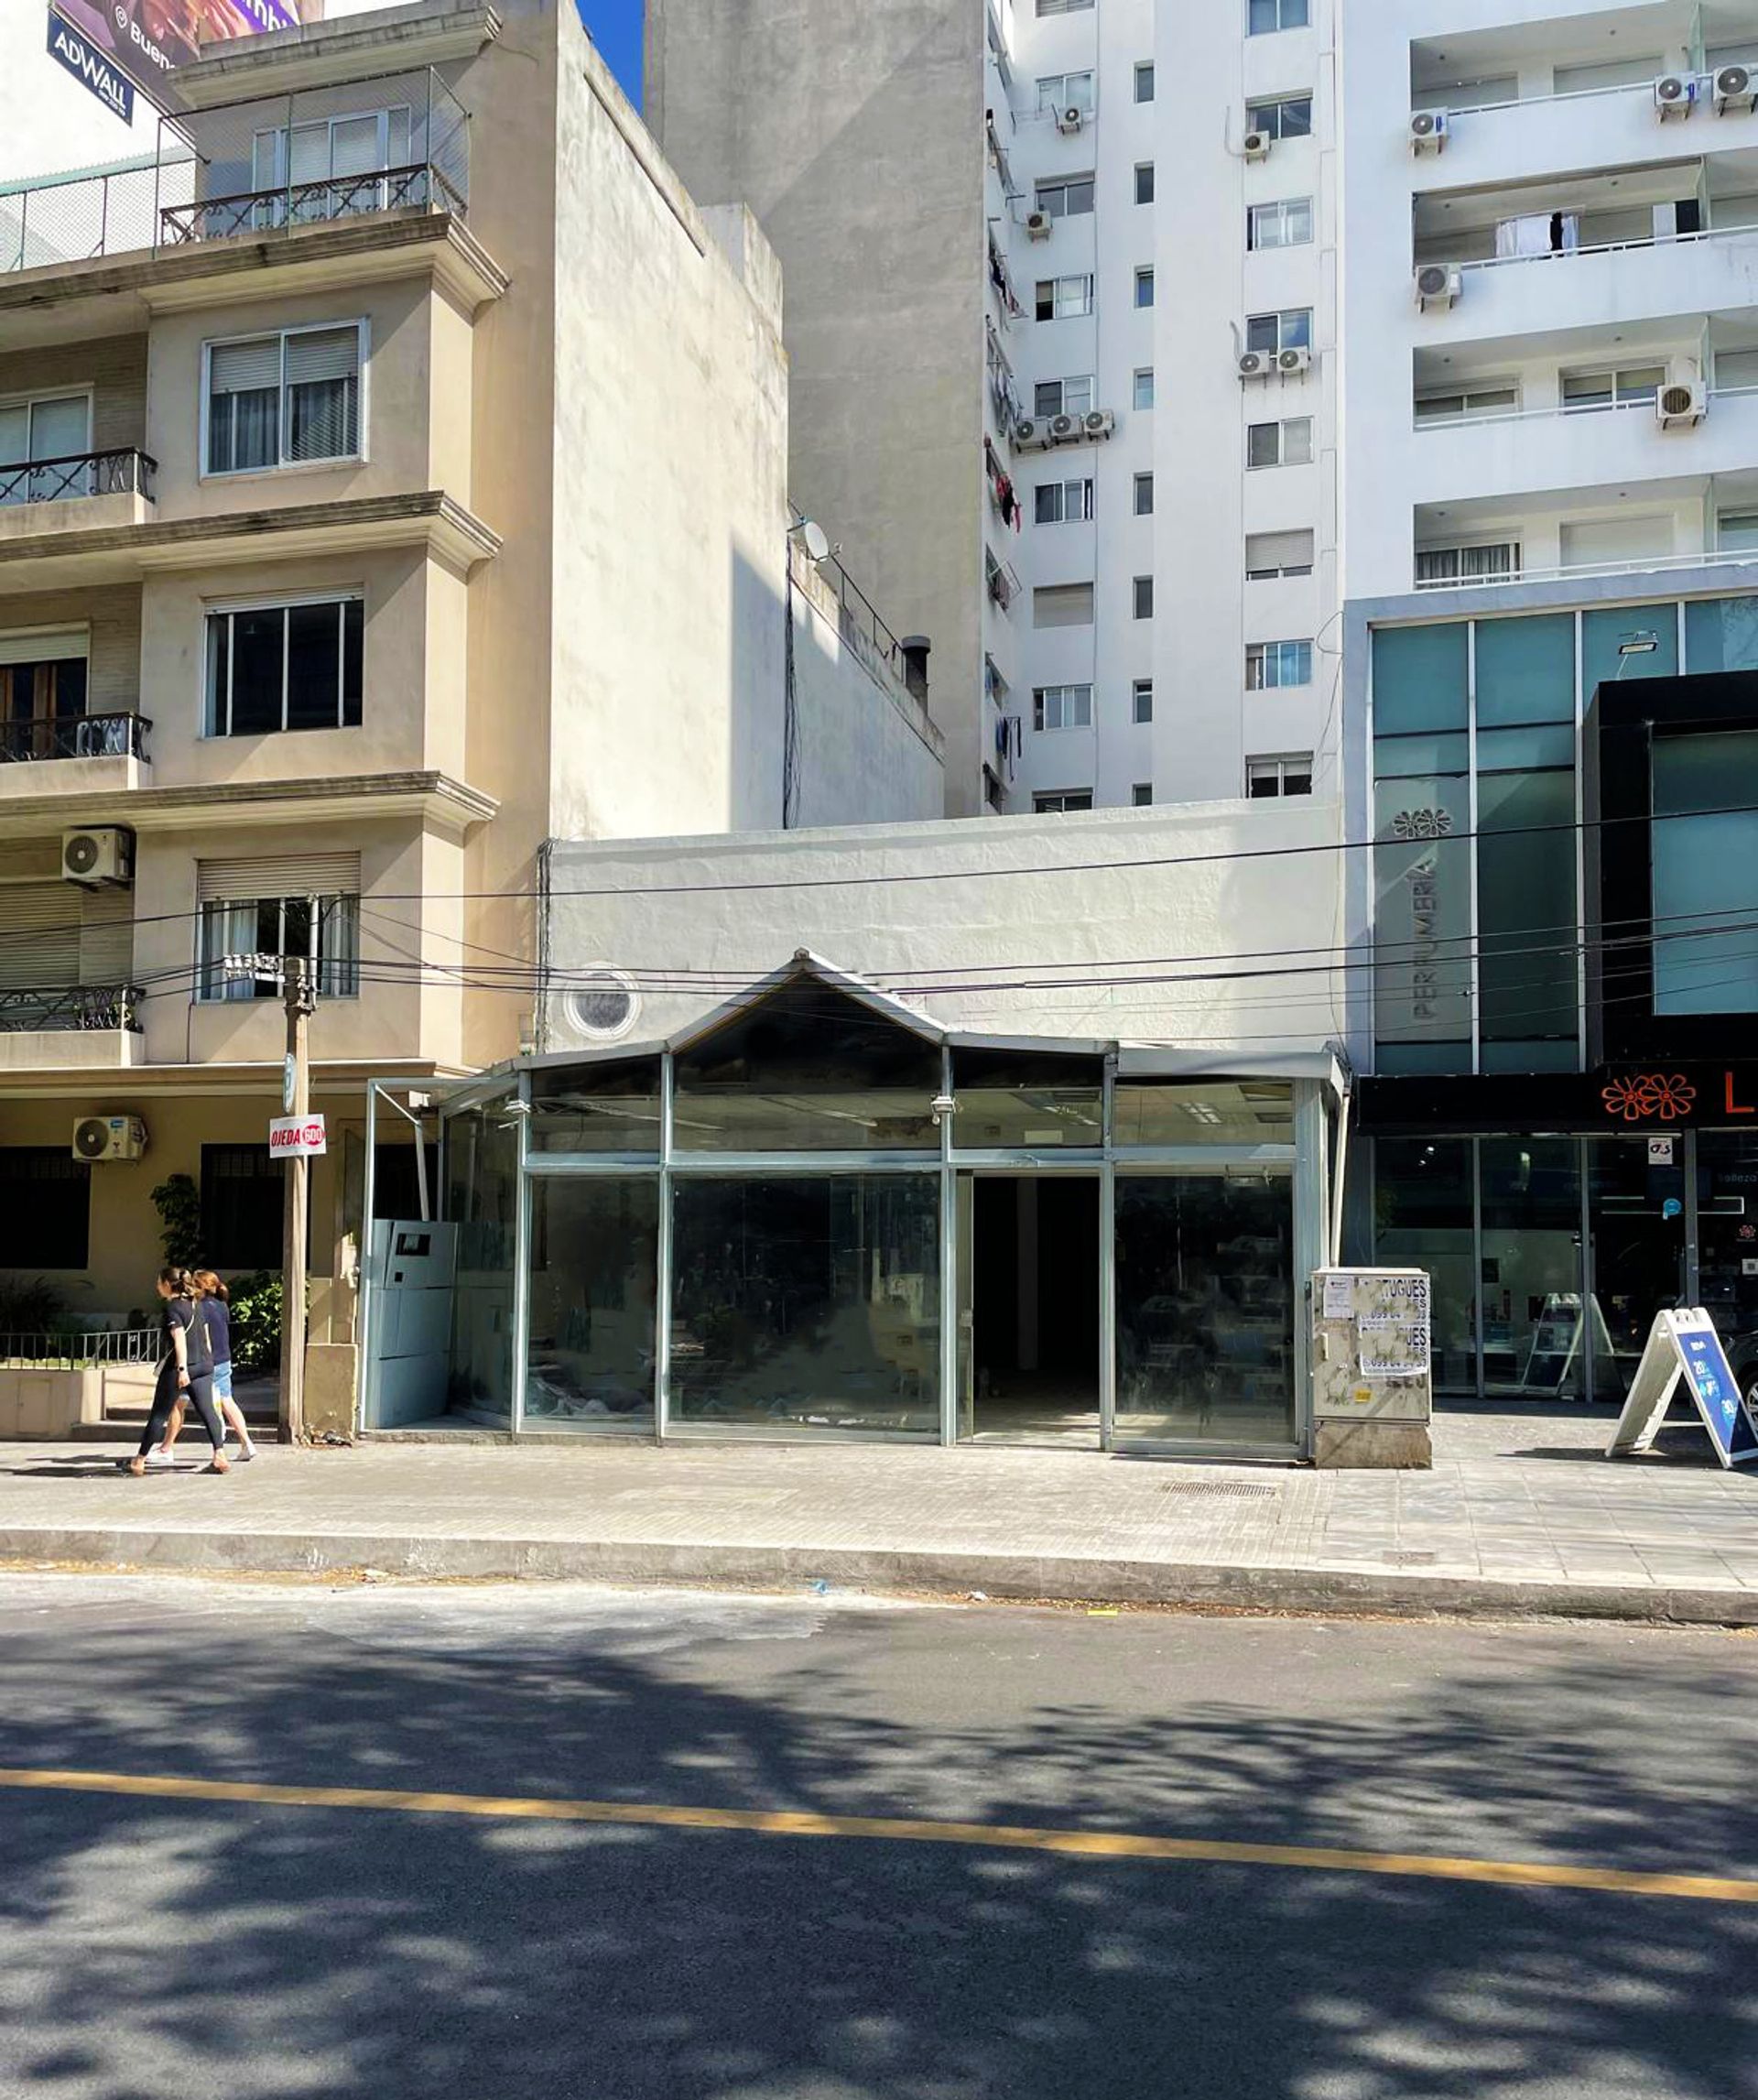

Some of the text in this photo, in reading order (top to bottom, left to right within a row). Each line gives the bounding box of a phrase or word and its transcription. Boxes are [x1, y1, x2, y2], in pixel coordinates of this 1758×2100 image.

[130, 21, 176, 71] Buen
[55, 31, 126, 110] ADWALL
[271, 1127, 300, 1148] OJEDA
[1374, 1278, 1427, 1298] TUGUES
